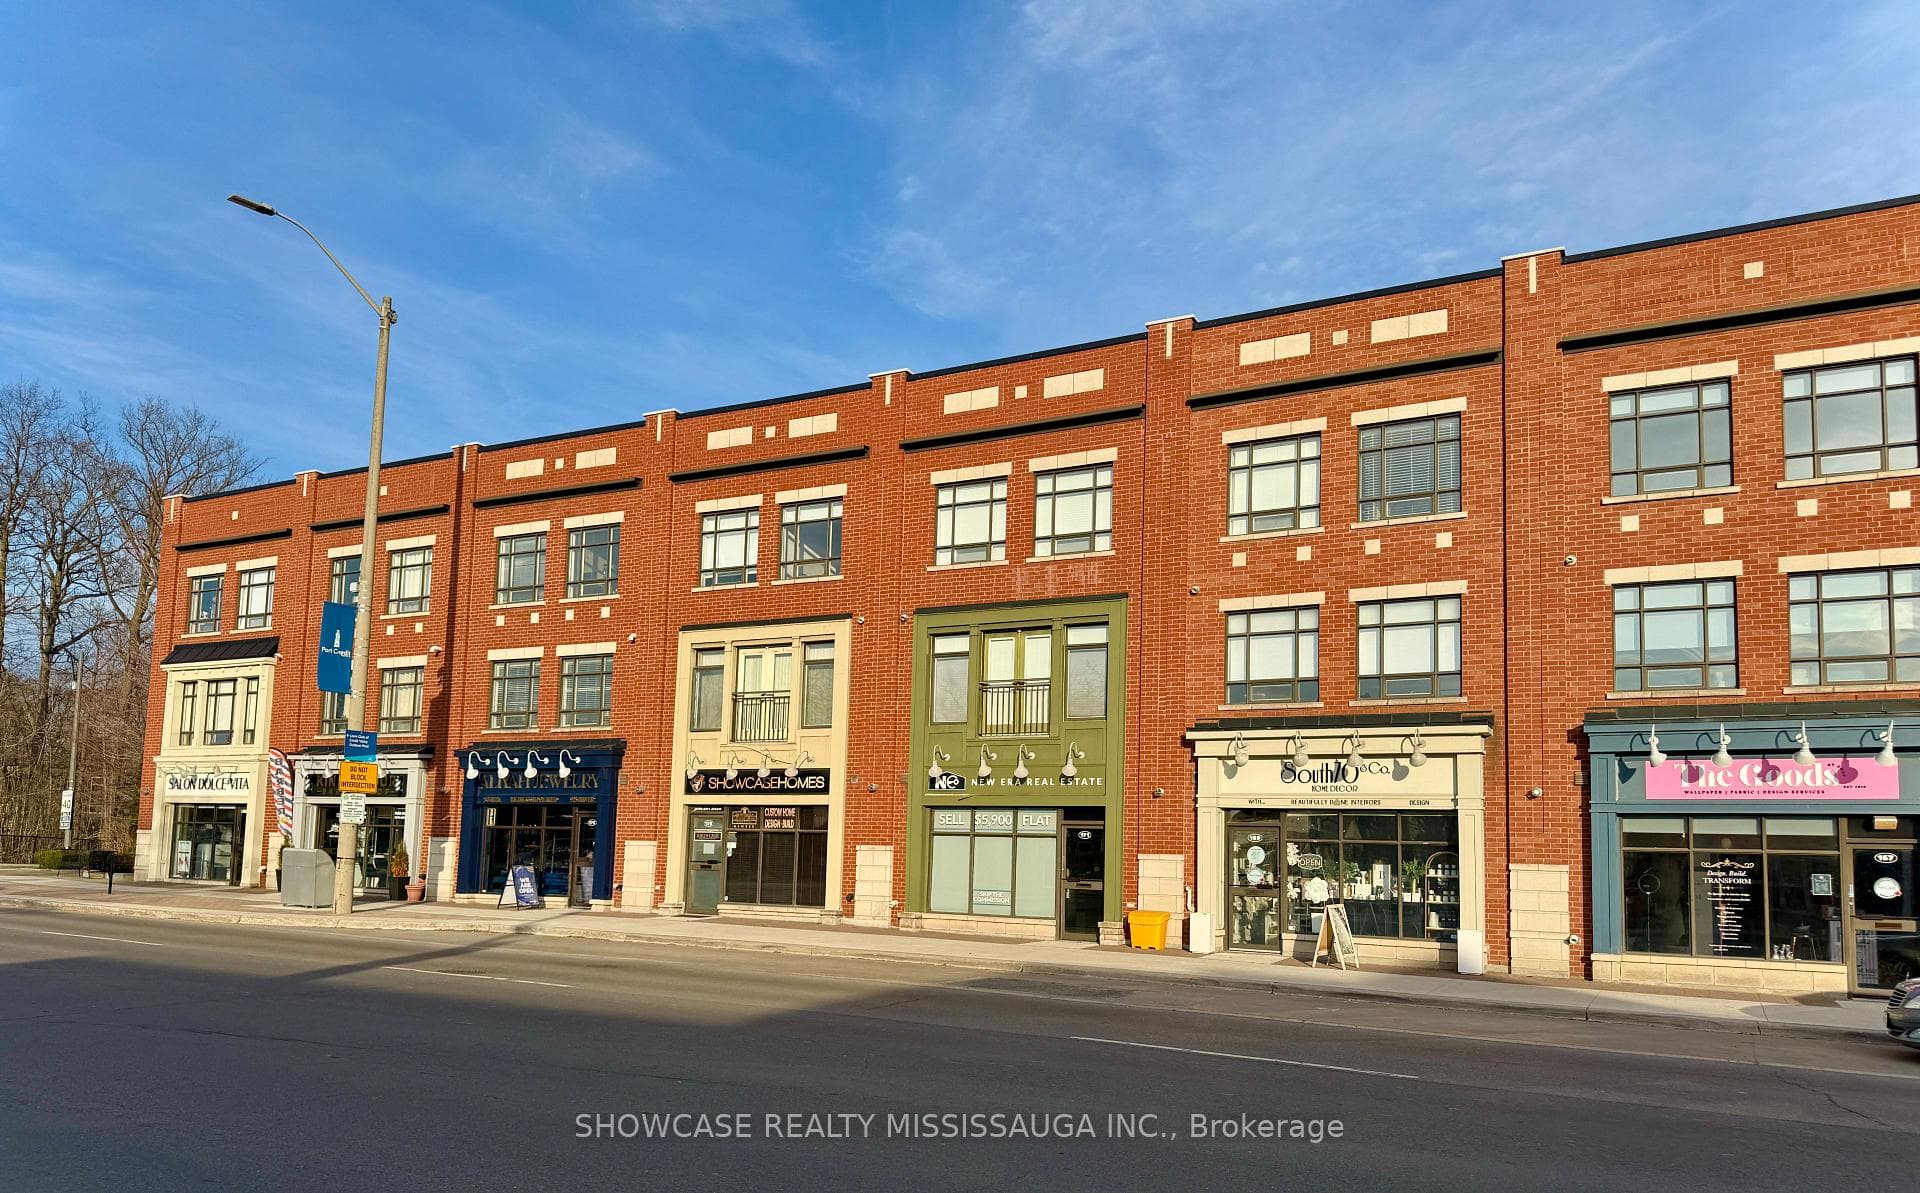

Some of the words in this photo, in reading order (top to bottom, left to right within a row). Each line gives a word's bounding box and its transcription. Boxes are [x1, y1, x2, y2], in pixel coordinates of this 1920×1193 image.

[333, 648, 351, 658] Credit
[1368, 762, 1390, 774] Co.
[1673, 762, 1734, 788] The
[1739, 762, 1839, 788] Goods
[168, 778, 197, 790] SALON
[198, 778, 226, 790] DOLCE
[228, 778, 250, 790] VITA
[340, 781, 376, 790] INTERSECTION
[971, 778, 996, 786] NEW
[1000, 778, 1022, 786] ERA
[1026, 778, 1055, 786] REAL
[1060, 777, 1103, 786] ESTATE
[62, 800, 71, 808] 40
[938, 814, 965, 826] SELL
[974, 814, 1012, 827] $5,900
[1022, 815, 1051, 827] FLAT
